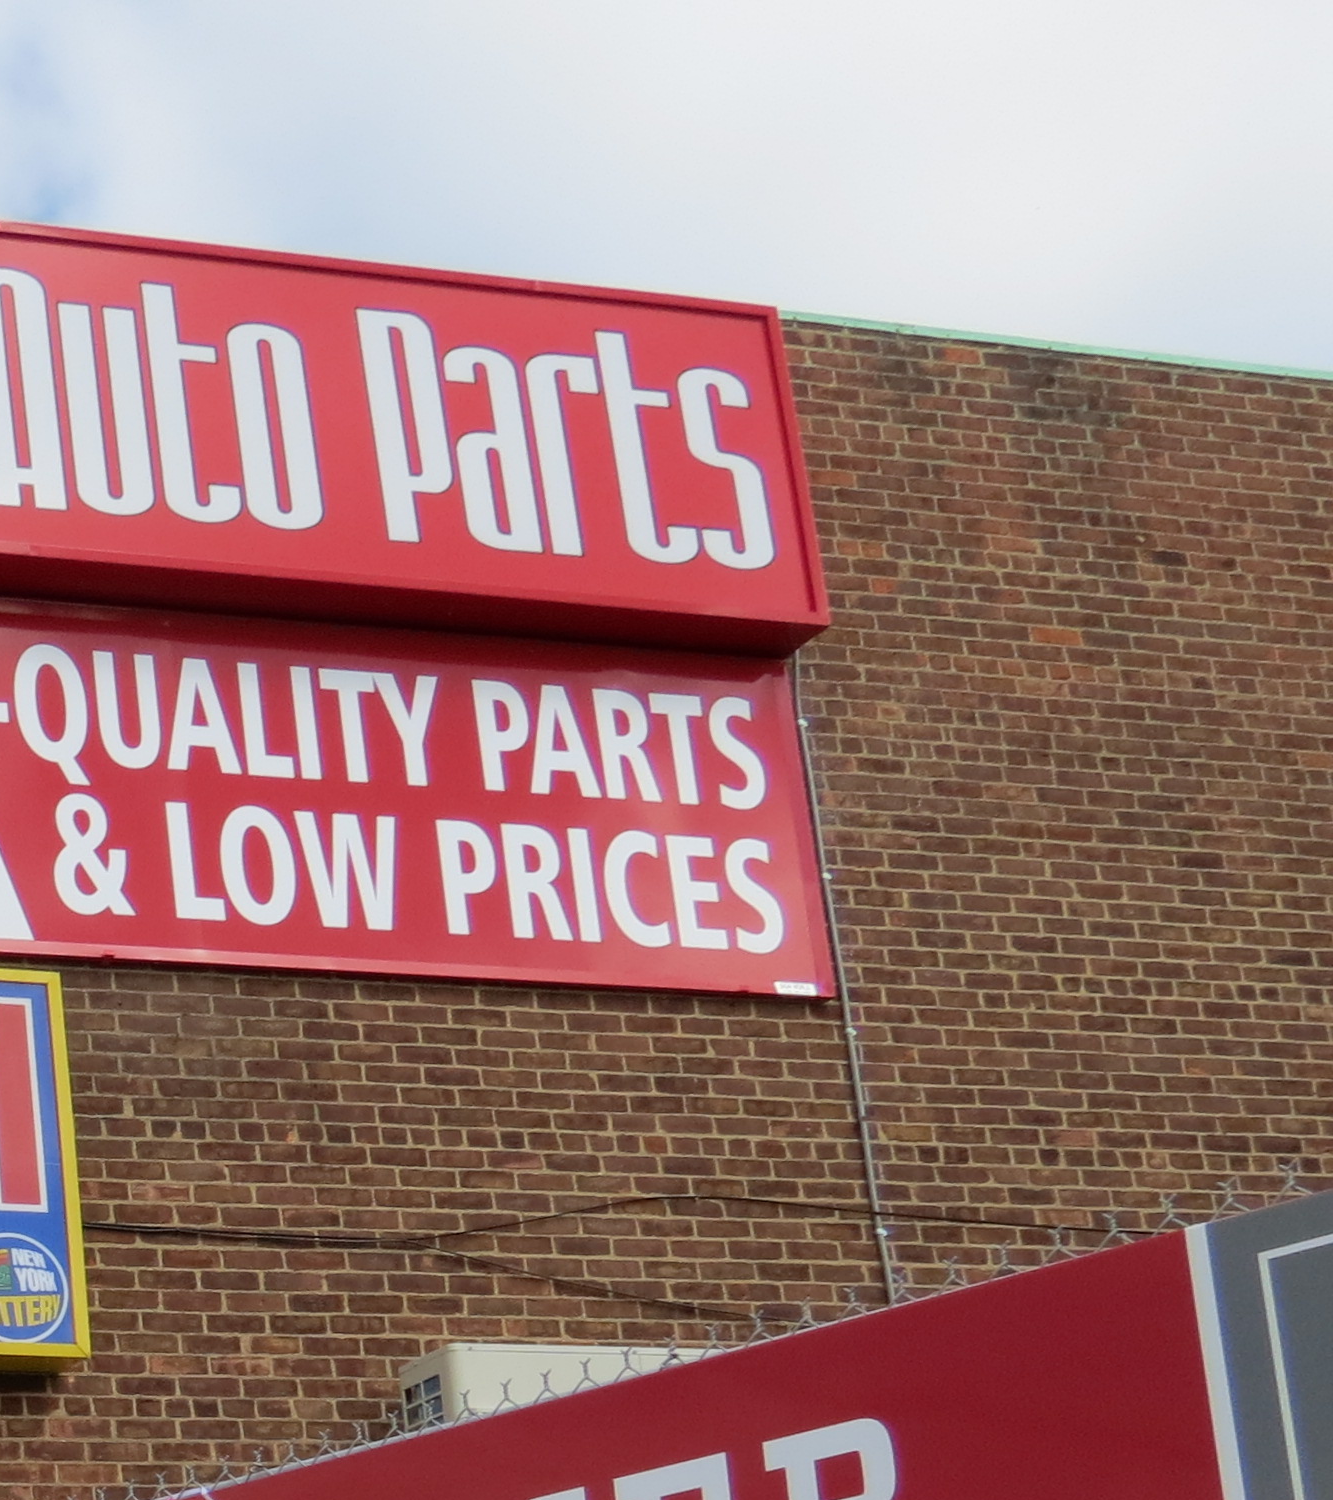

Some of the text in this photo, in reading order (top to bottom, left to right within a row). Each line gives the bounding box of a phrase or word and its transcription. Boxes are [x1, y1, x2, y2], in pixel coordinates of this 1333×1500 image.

[354, 306, 777, 571] Parts
[470, 678, 767, 811] PARTS
[52, 791, 787, 956] & LOW PRICES
[10, 1247, 48, 1269] NEW
[13, 1266, 58, 1293] YORK
